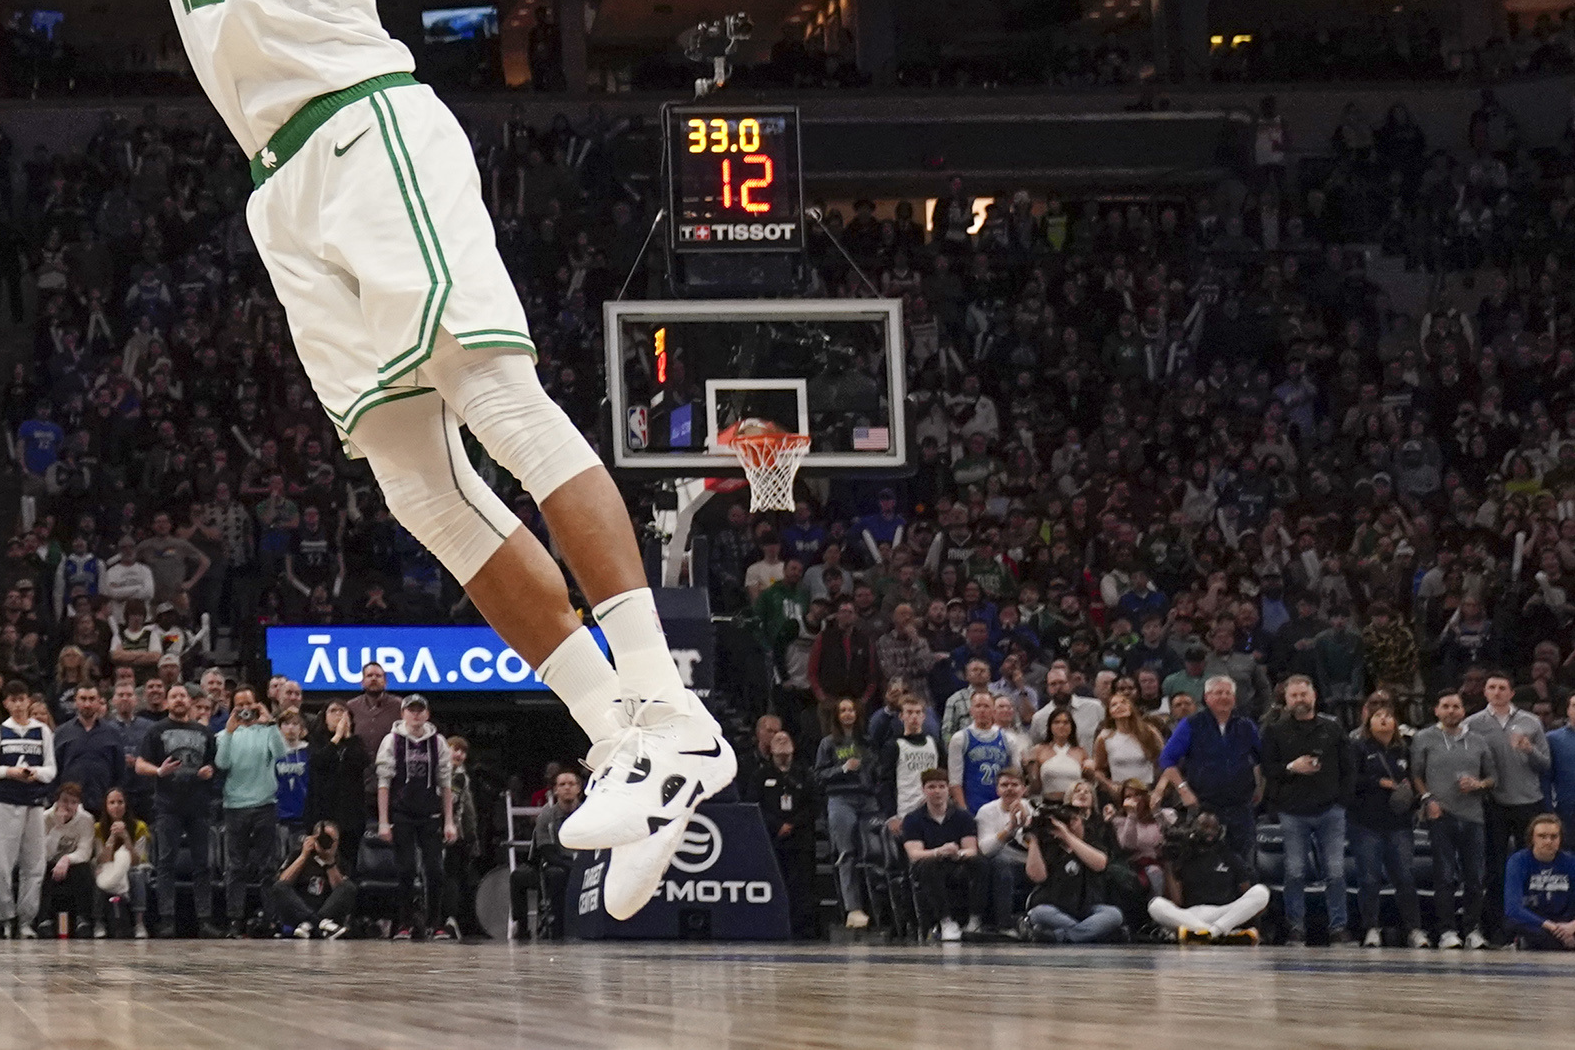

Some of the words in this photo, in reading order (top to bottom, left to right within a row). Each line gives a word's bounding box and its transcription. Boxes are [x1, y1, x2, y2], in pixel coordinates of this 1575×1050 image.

[688, 118, 760, 153] 33.0
[722, 154, 773, 213] 12
[711, 223, 796, 241] TISSOT
